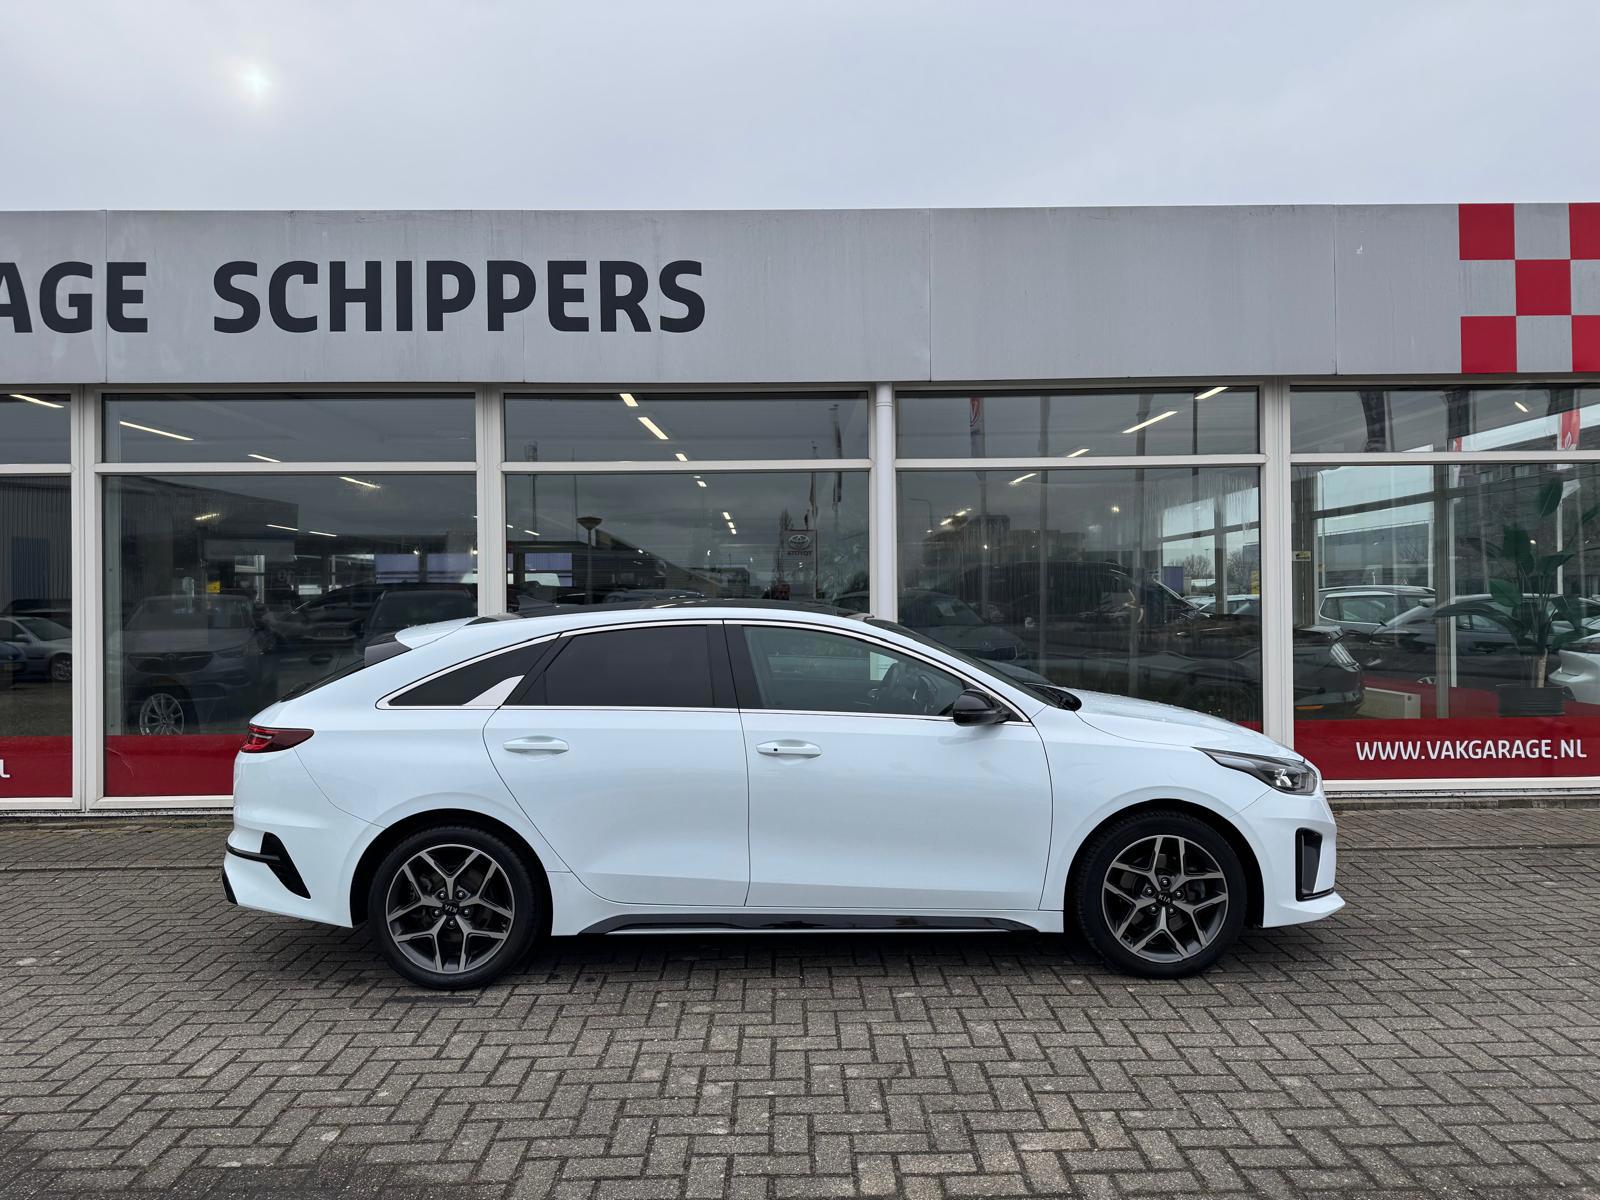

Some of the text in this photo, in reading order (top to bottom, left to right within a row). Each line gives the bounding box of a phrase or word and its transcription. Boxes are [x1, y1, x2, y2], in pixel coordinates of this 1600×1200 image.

[0, 260, 706, 334] AGE SCHIPPERS
[1355, 738, 1588, 761] WWW.VAKGARAGE.NL
